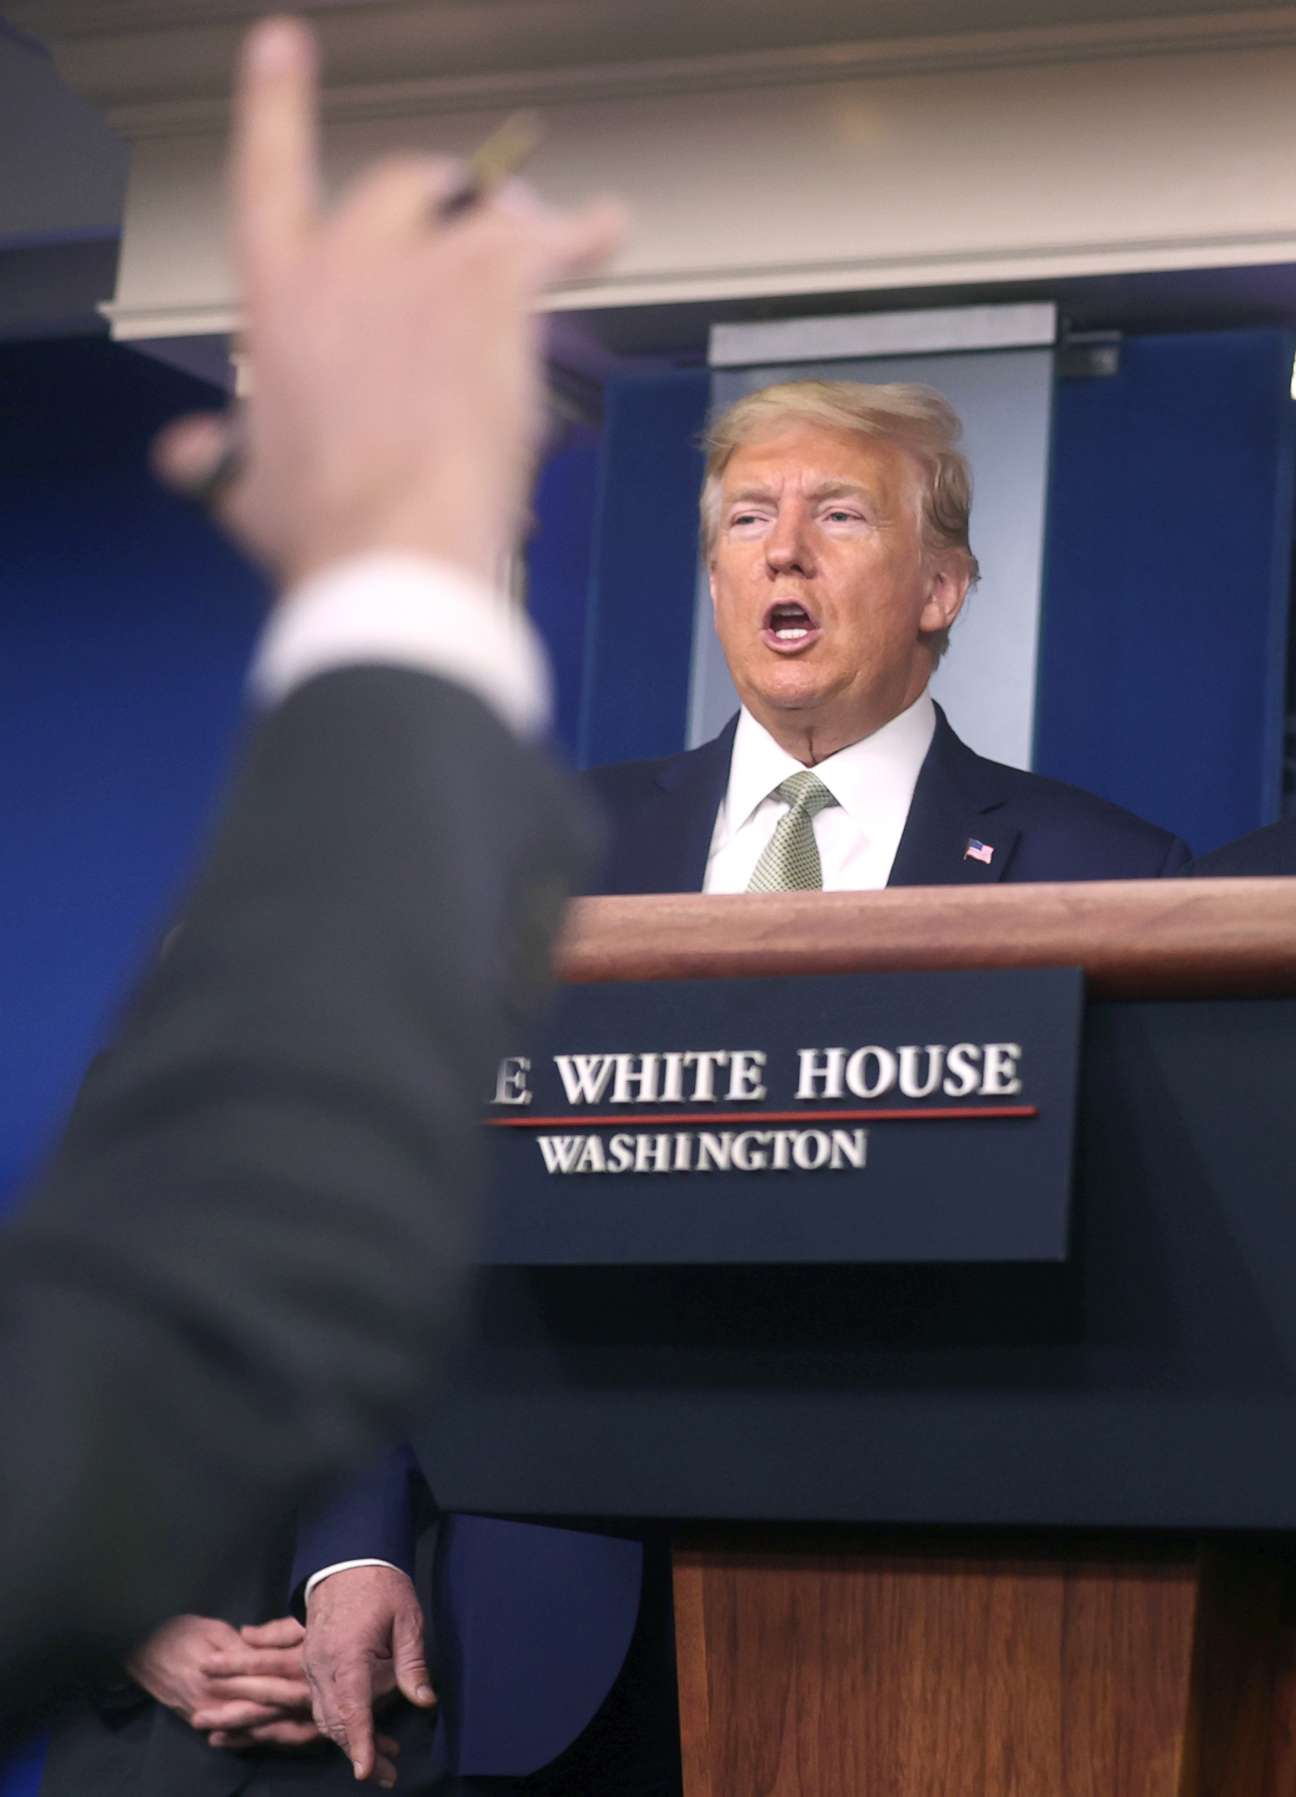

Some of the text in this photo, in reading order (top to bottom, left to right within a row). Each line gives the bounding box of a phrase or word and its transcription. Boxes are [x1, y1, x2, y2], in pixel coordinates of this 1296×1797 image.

[554, 1050, 768, 1104] WHITE
[795, 1043, 1023, 1099] HOUSE
[537, 1129, 868, 1174] WASHINGTON
